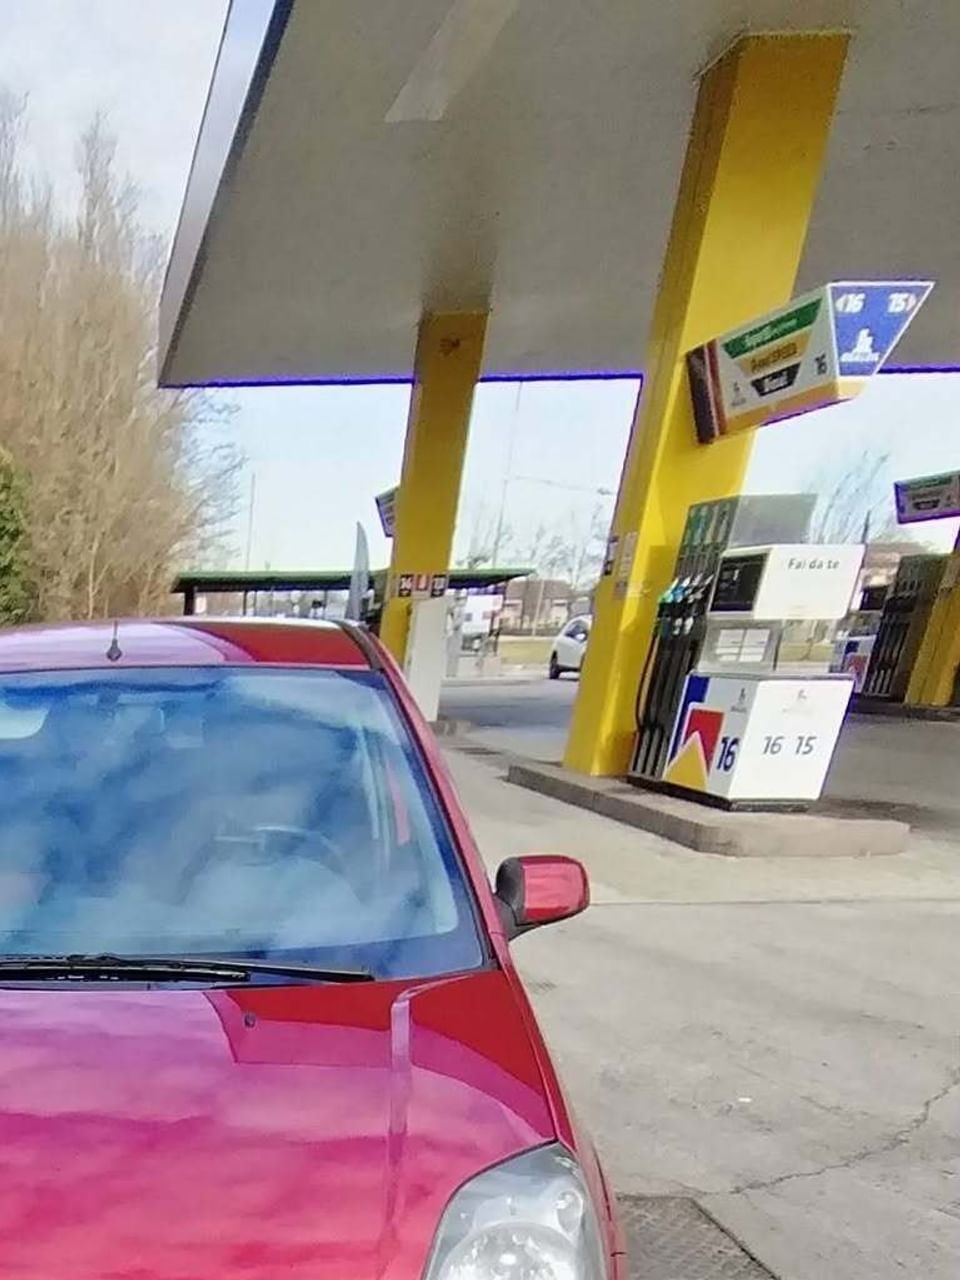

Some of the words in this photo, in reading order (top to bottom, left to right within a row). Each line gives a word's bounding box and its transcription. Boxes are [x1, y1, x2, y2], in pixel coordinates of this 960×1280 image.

[808, 558, 824, 569] da
[826, 559, 840, 569] te
[717, 736, 740, 772] 16
[763, 735, 785, 755] 16
[795, 735, 817, 755] 15
